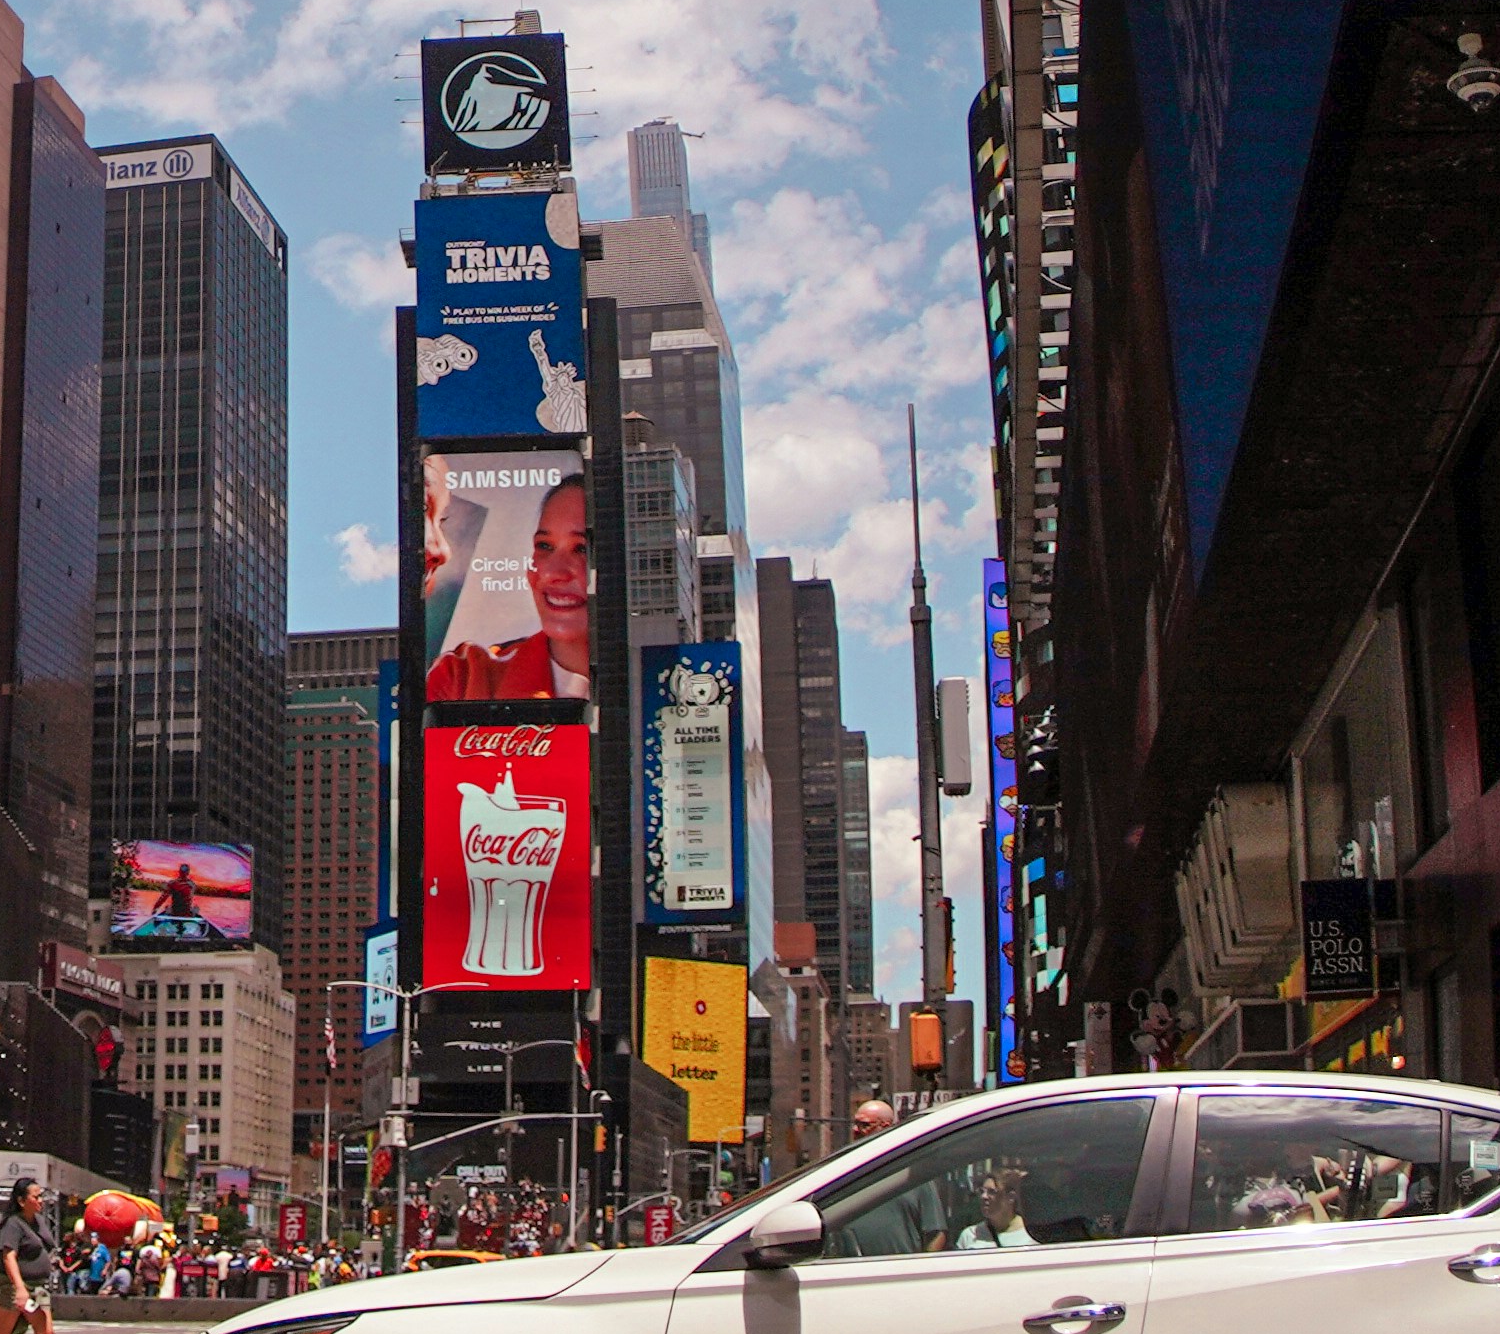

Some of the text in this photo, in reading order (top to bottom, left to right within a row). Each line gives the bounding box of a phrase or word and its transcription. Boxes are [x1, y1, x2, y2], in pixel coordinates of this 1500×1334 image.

[445, 244, 551, 269] TRIVIA
[446, 265, 551, 284] MOMENTS
[443, 313, 556, 325] FREE BUS OR SUBWAY RIDES
[453, 305, 545, 316] PLAY TO WIN A WEEK OF
[445, 468, 561, 489] SAMSUNG
[471, 556, 538, 573] Circle it,
[481, 576, 530, 592] find it
[674, 726, 720, 736] ALL TIME
[674, 734, 722, 745] LEADERS
[454, 724, 556, 758] Coca-Cola
[465, 823, 563, 867] Coca-Cola
[689, 887, 726, 896] TRIVIA
[1310, 919, 1345, 938] U.S.
[1310, 937, 1363, 957] POLO
[1312, 956, 1369, 976] ASSN.
[469, 1020, 502, 1029] THE
[466, 1065, 504, 1073] LIES
[670, 1063, 719, 1081] letter
[651, 1207, 669, 1243] tkts
